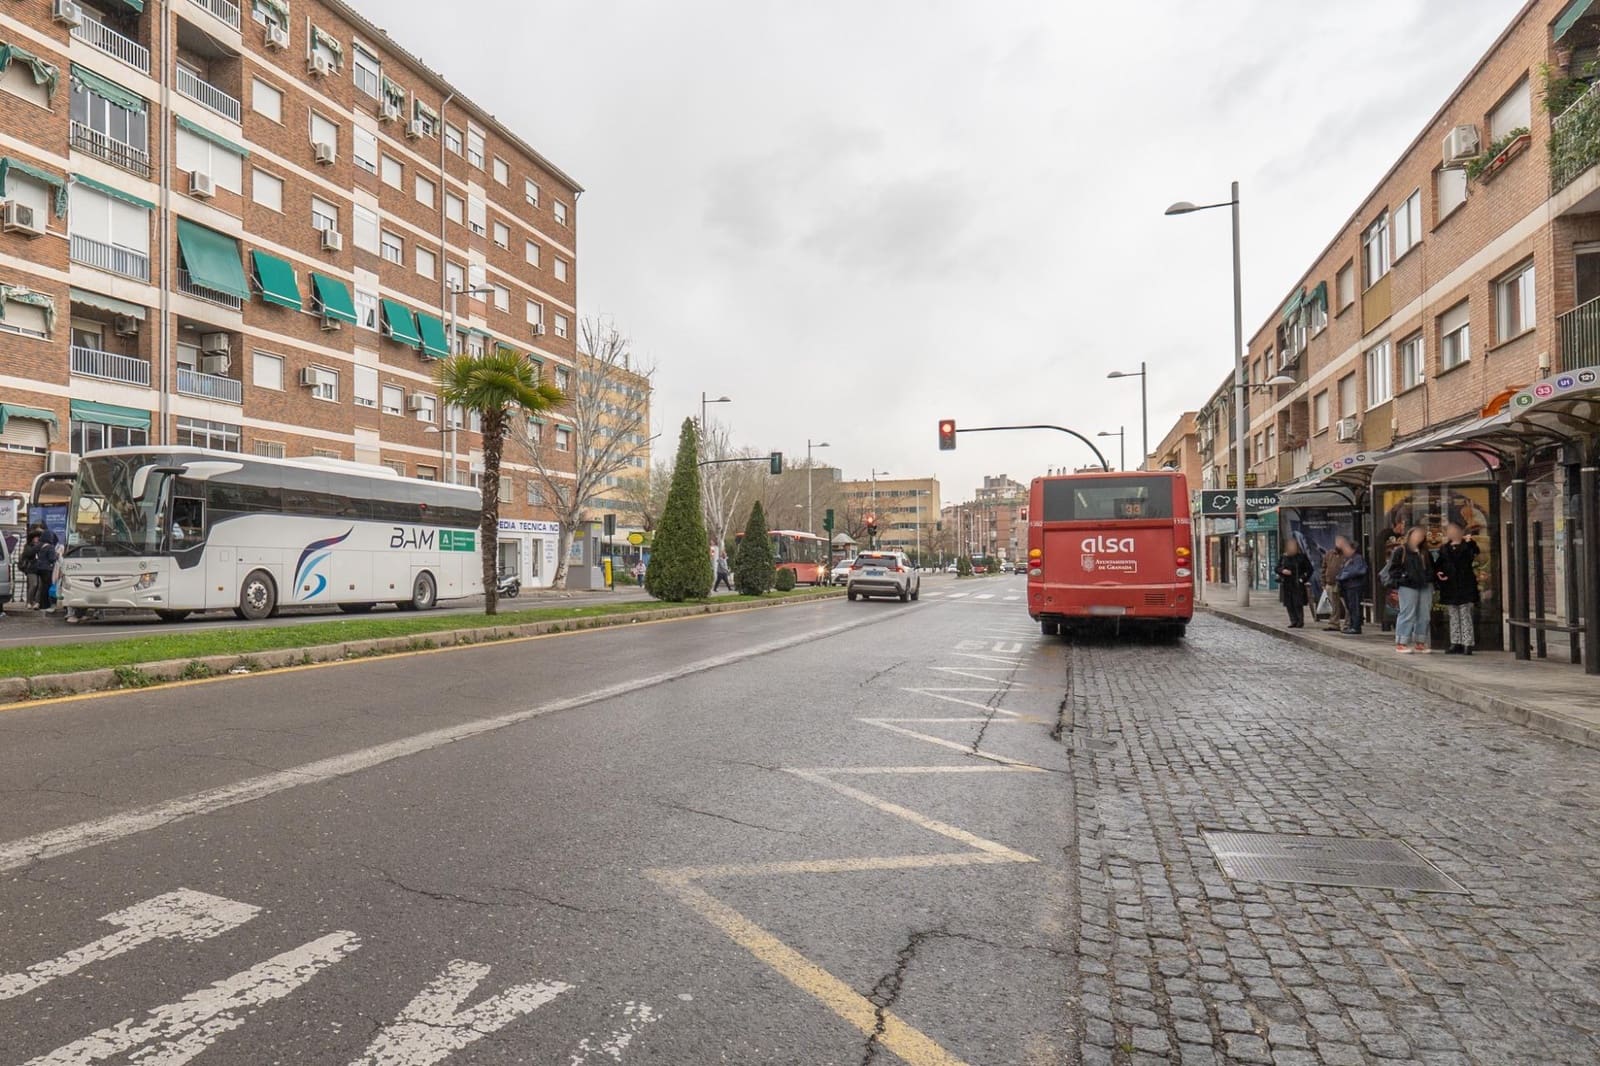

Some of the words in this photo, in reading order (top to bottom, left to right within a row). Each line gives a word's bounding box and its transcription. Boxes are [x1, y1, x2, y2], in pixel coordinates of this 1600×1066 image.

[1537, 387, 1550, 395] 33
[519, 522, 547, 531] TECNICA
[390, 527, 435, 550] BAM
[1081, 535, 1135, 553] alsa
